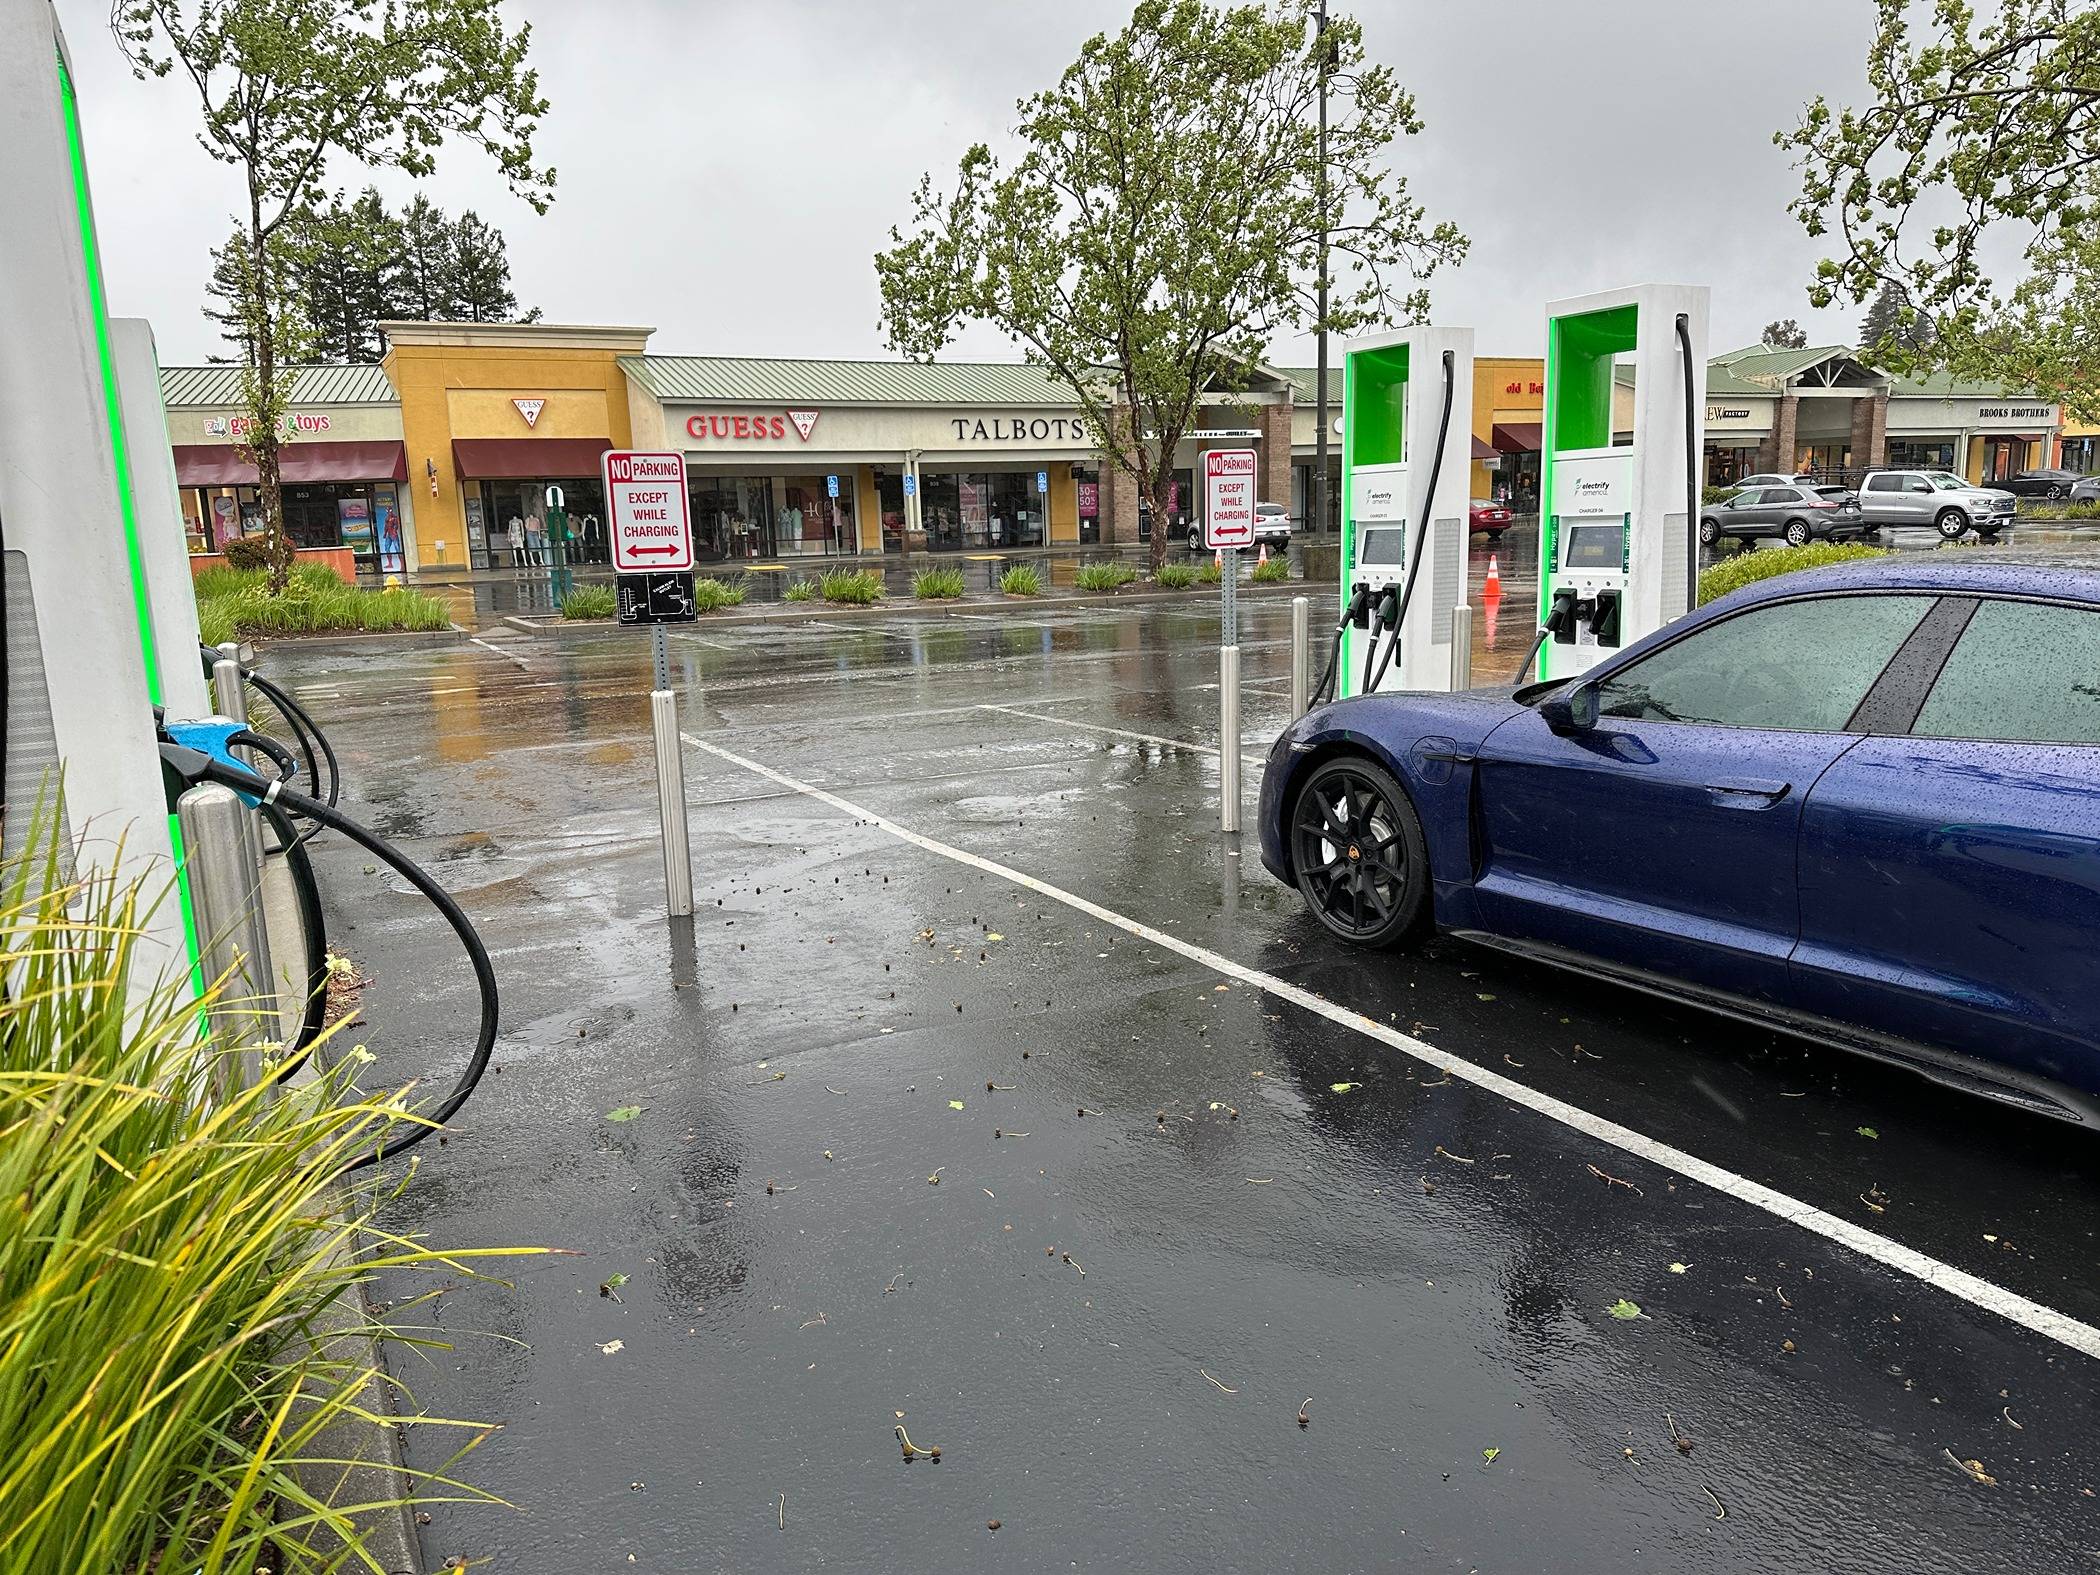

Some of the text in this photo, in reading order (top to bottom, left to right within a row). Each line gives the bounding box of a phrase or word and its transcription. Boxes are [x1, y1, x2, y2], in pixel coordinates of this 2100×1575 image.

[1506, 382, 1522, 394] old
[1979, 408, 2050, 418] BROOKS BROTHERS
[686, 415, 786, 440] GUESS
[951, 418, 1084, 440] TALBOTS
[611, 459, 679, 480] NO PARKING
[1209, 457, 1253, 474] NO PARKING
[1218, 483, 1245, 493] EXCEPT
[1582, 482, 1610, 490] electrify
[628, 492, 669, 504] EXCEPT
[1220, 497, 1243, 507] WHILE
[633, 509, 667, 521] WHILE
[1214, 510, 1249, 521] CHARGING
[624, 526, 679, 538] CHARGING
